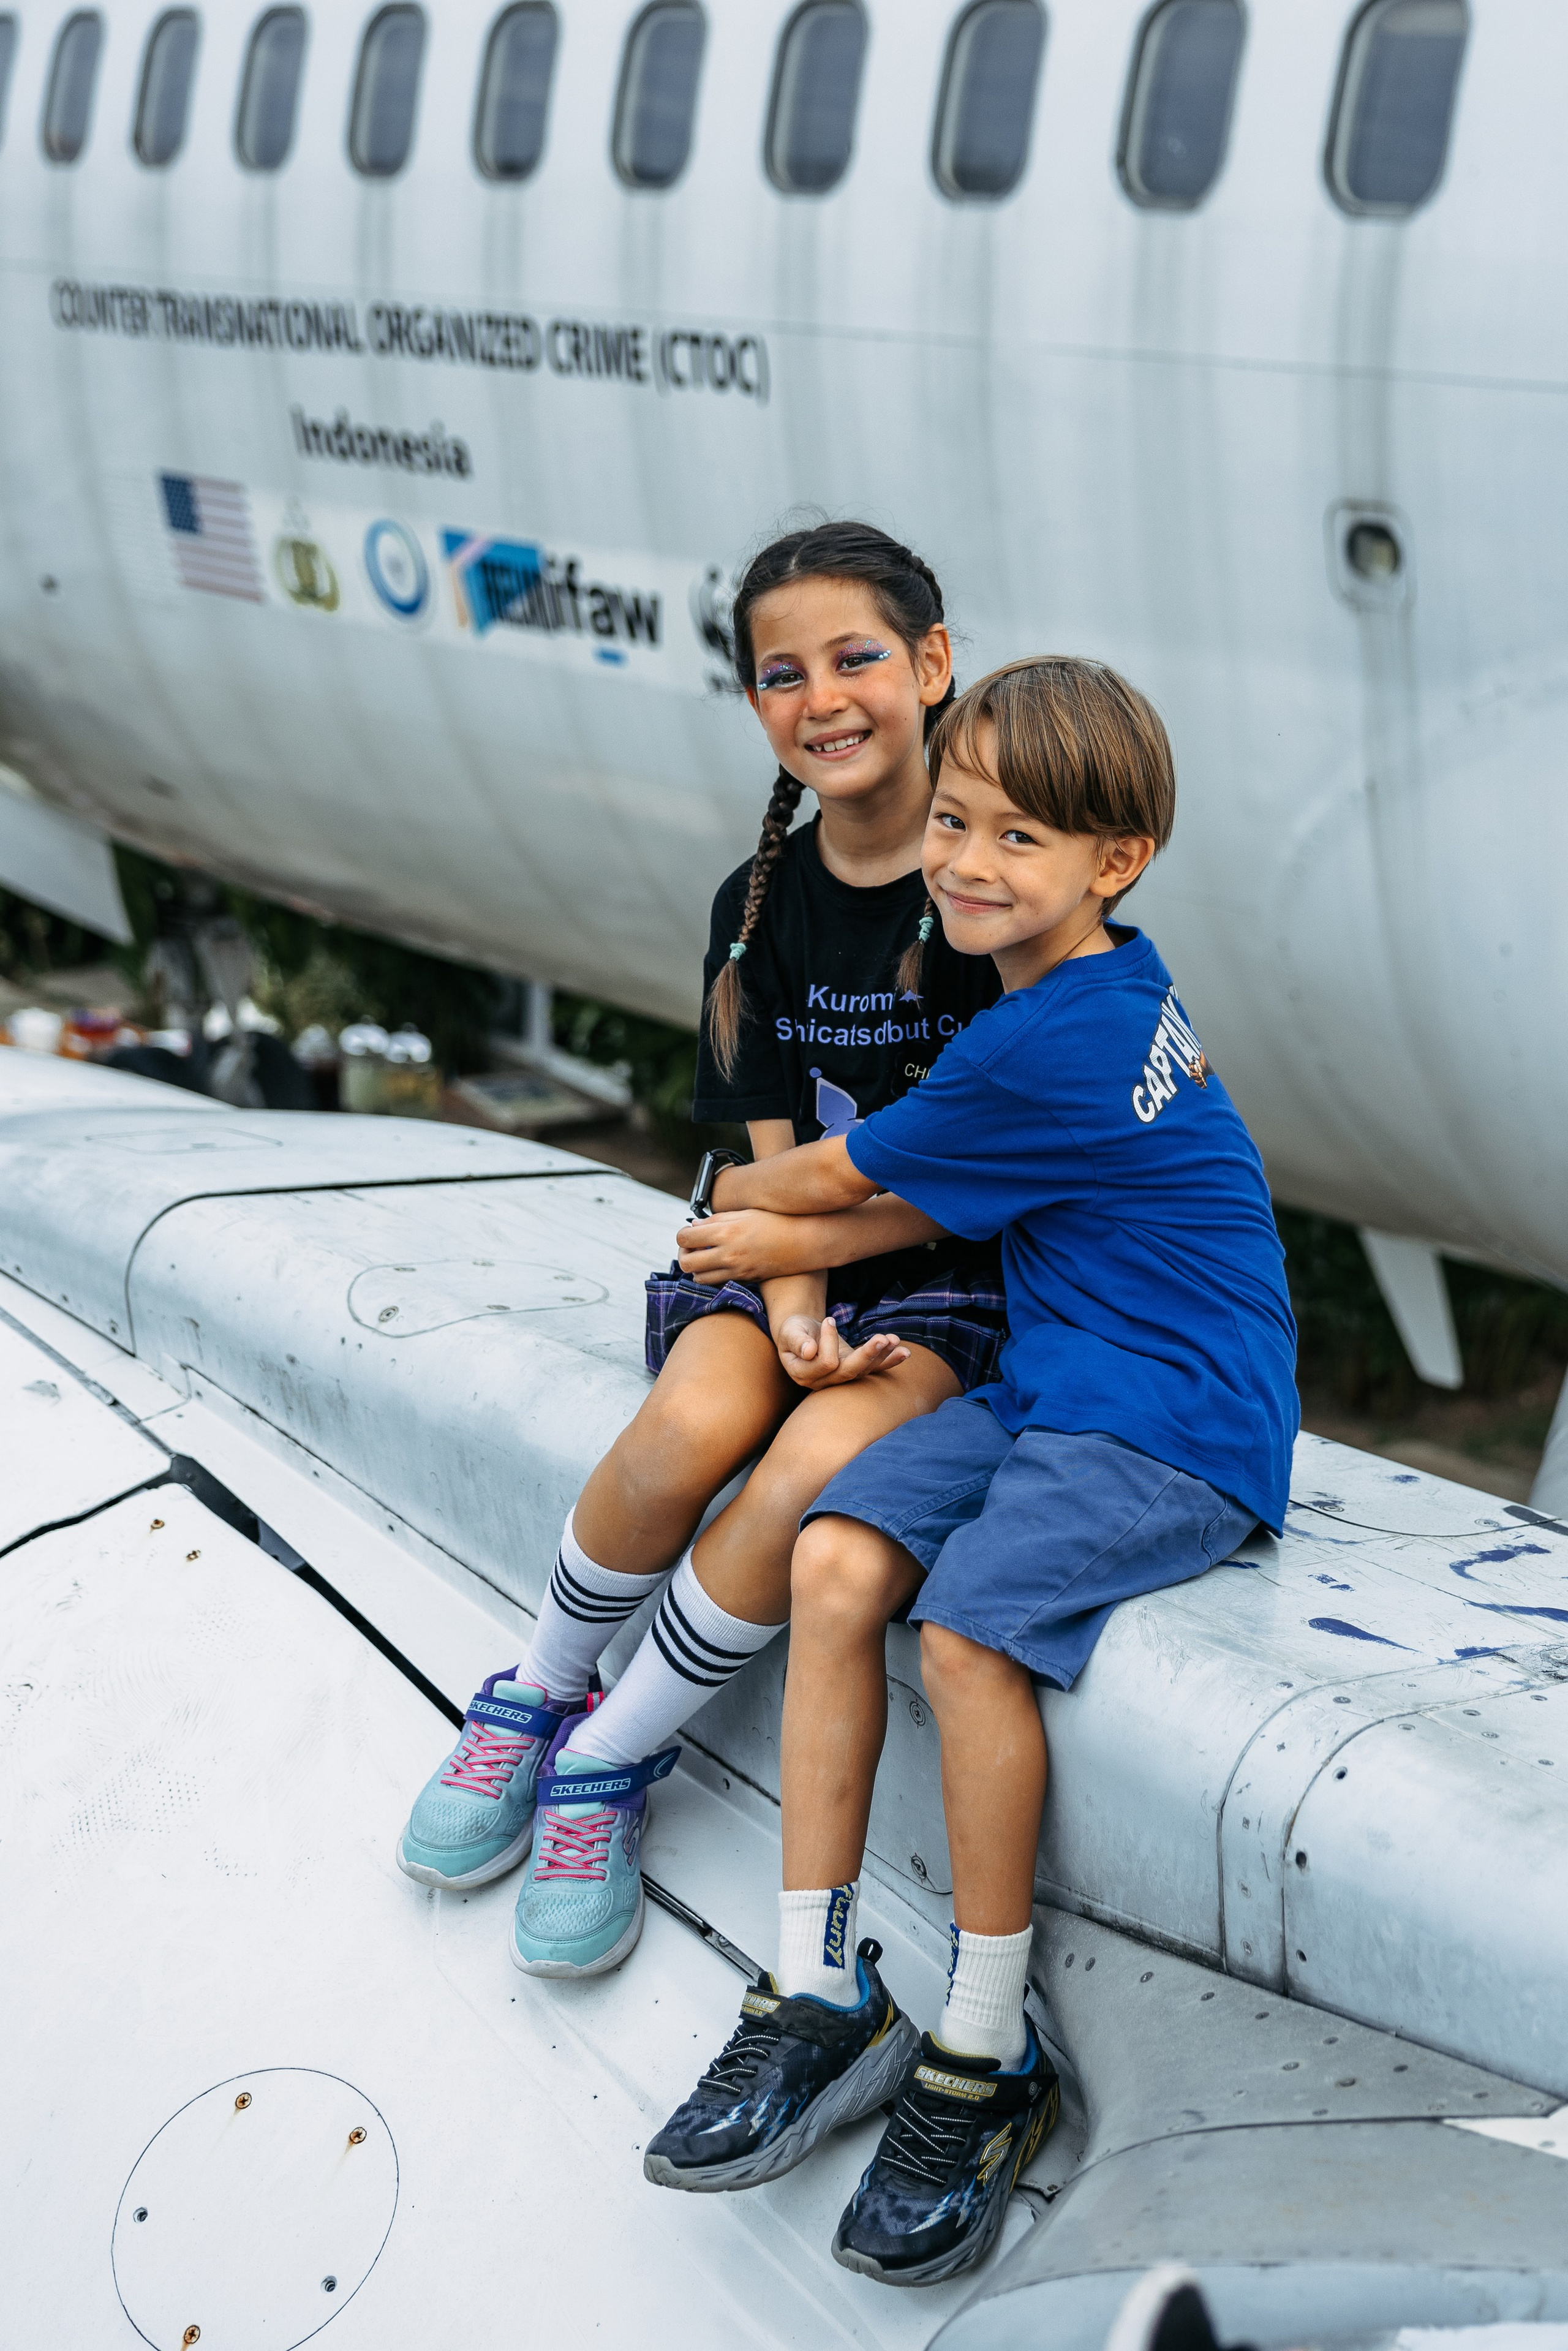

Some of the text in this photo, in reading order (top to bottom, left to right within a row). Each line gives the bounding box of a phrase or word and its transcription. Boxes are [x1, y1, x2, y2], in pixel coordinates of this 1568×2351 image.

[51, 281, 769, 406] COUNTER TRANSNATIONAL ORGANIZED CRIME (CTOC)
[291, 404, 472, 480] Indonesia
[807, 984, 897, 1012] Kurom
[551, 1778, 631, 1796] SKECHERS
[914, 2066, 998, 2097] SKECHERS
[924, 2083, 967, 2098] LIGHT-STORM
